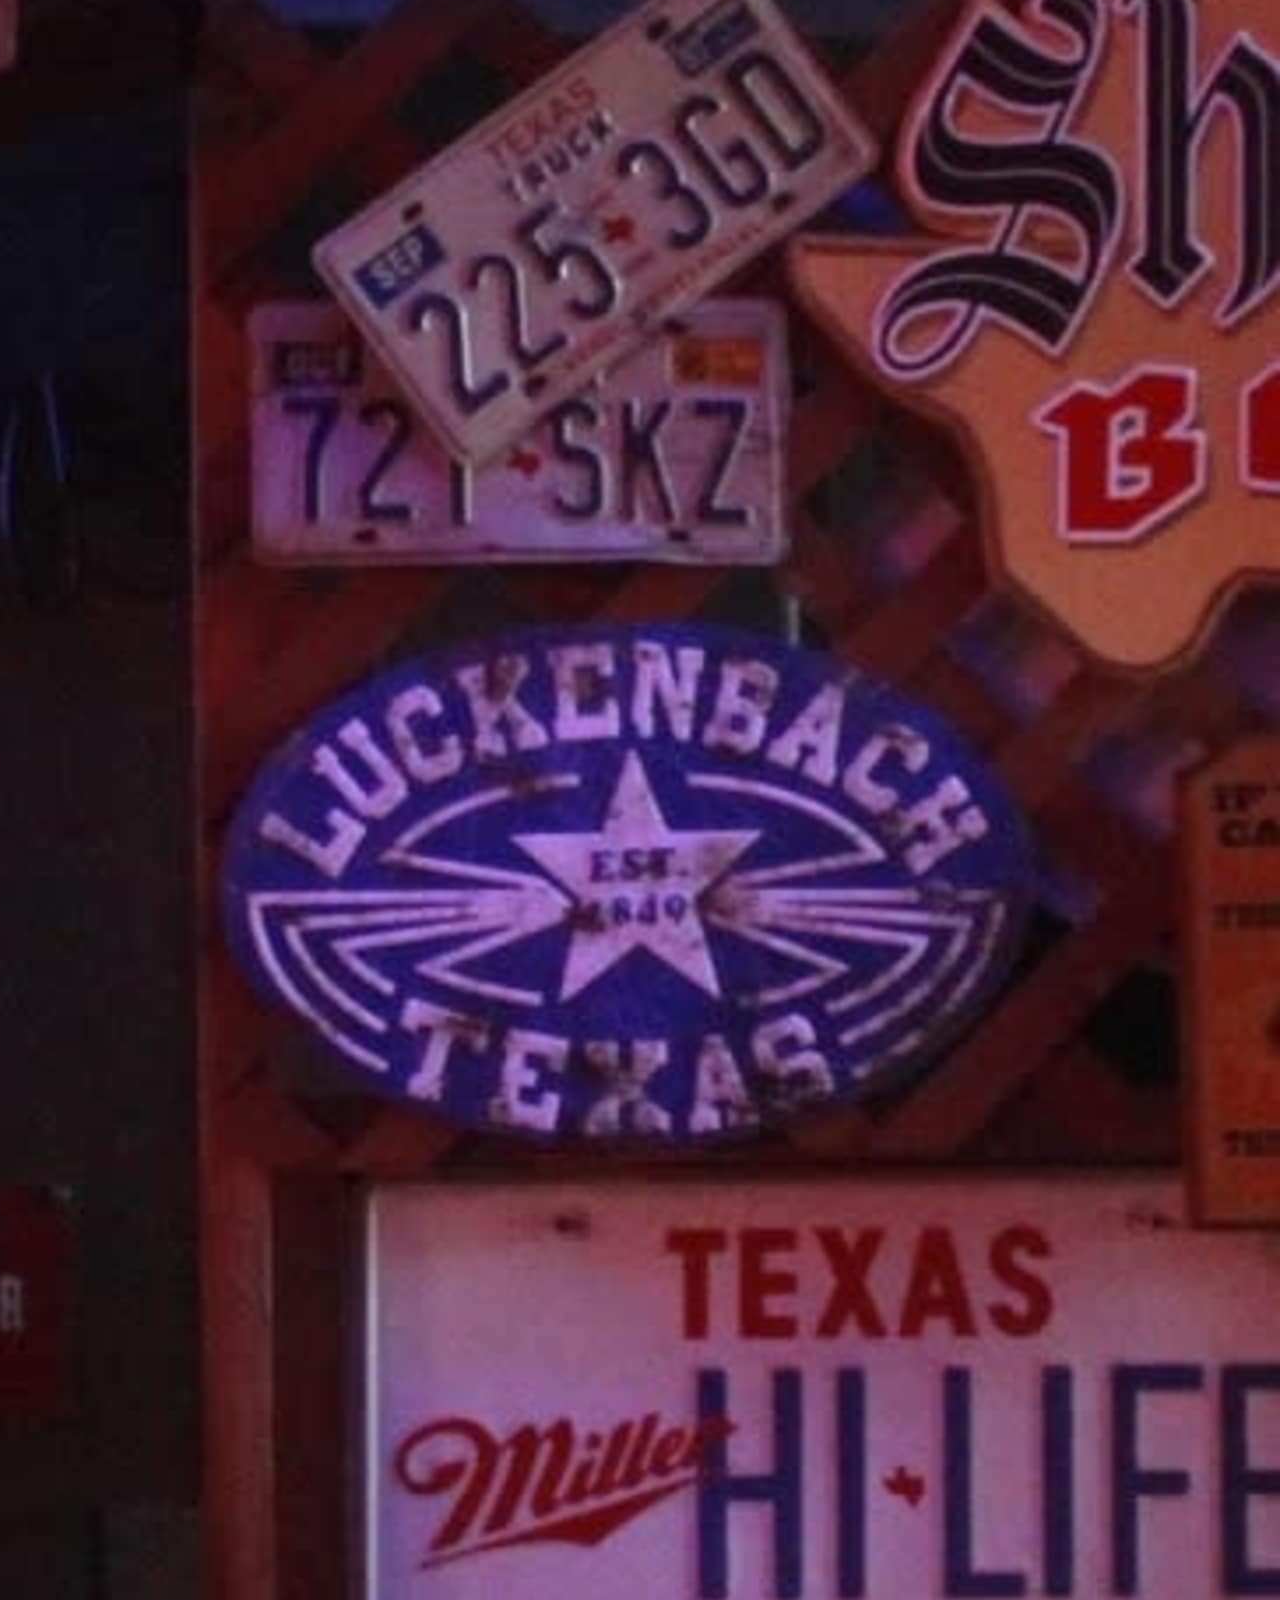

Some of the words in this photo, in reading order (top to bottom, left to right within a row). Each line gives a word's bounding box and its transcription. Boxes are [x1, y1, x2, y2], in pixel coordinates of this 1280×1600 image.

[490, 76, 597, 169] TEXAS
[502, 108, 614, 200] TRUCK
[366, 232, 424, 291] SEP
[550, 396, 752, 526] SKZ
[258, 639, 990, 879] LUCKENBACH
[398, 998, 838, 1135] TEXAS
[665, 1227, 1057, 1341] TEXAS
[392, 1412, 739, 1556] Miller
